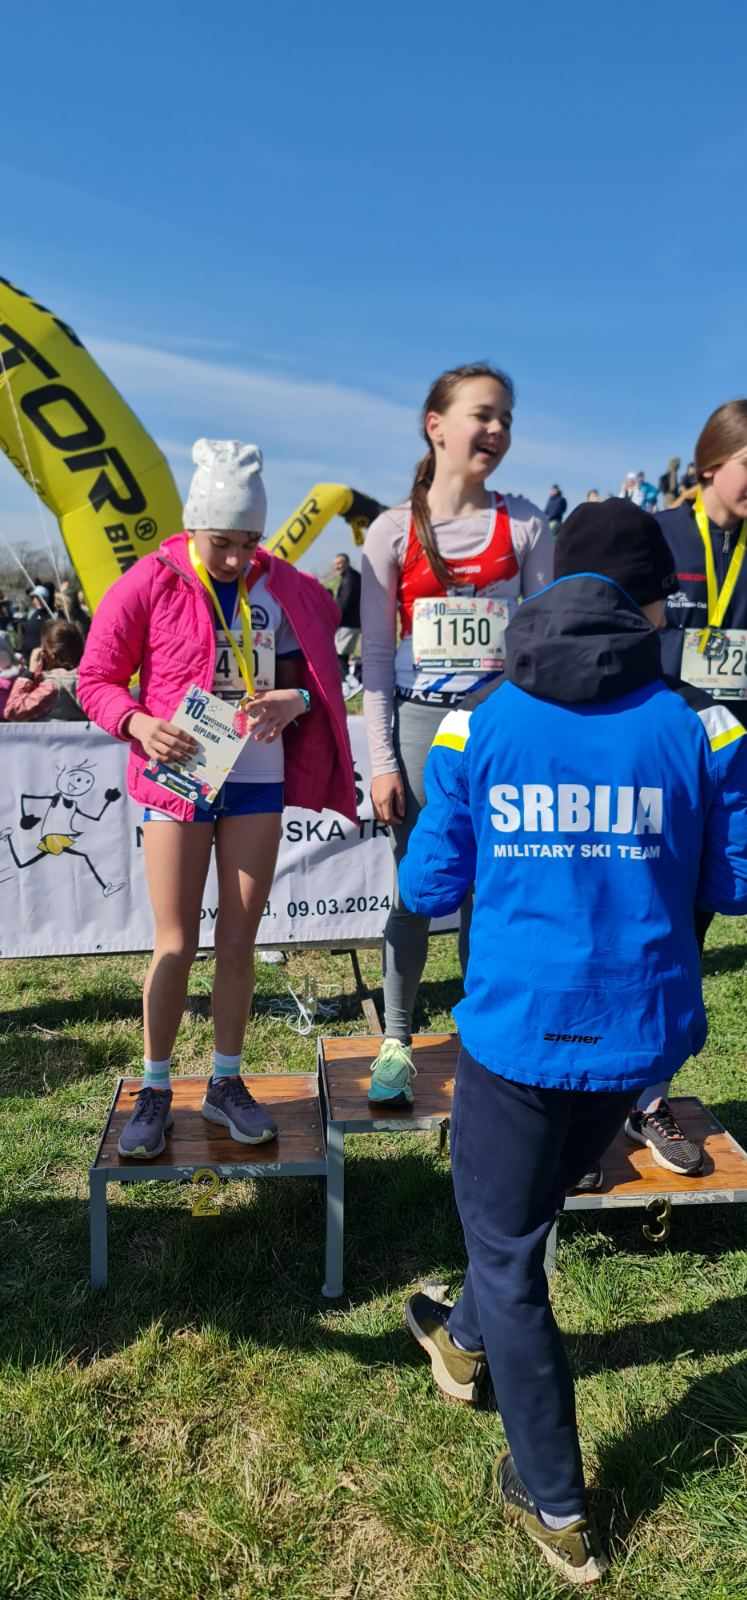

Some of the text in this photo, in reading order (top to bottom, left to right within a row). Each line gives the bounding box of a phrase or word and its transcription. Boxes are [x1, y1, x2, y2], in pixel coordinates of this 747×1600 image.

[434, 618, 490, 646] 1150
[707, 648, 747, 676] 122
[192, 724, 221, 744] DIPLOMA
[488, 784, 663, 835] SRBIJA
[280, 816, 389, 842] SKA TR
[494, 844, 661, 860] MILITARY SKI TEAM
[287, 895, 392, 918] 09.03.2024
[191, 1168, 221, 1217] 2
[642, 1198, 672, 1242] 3
